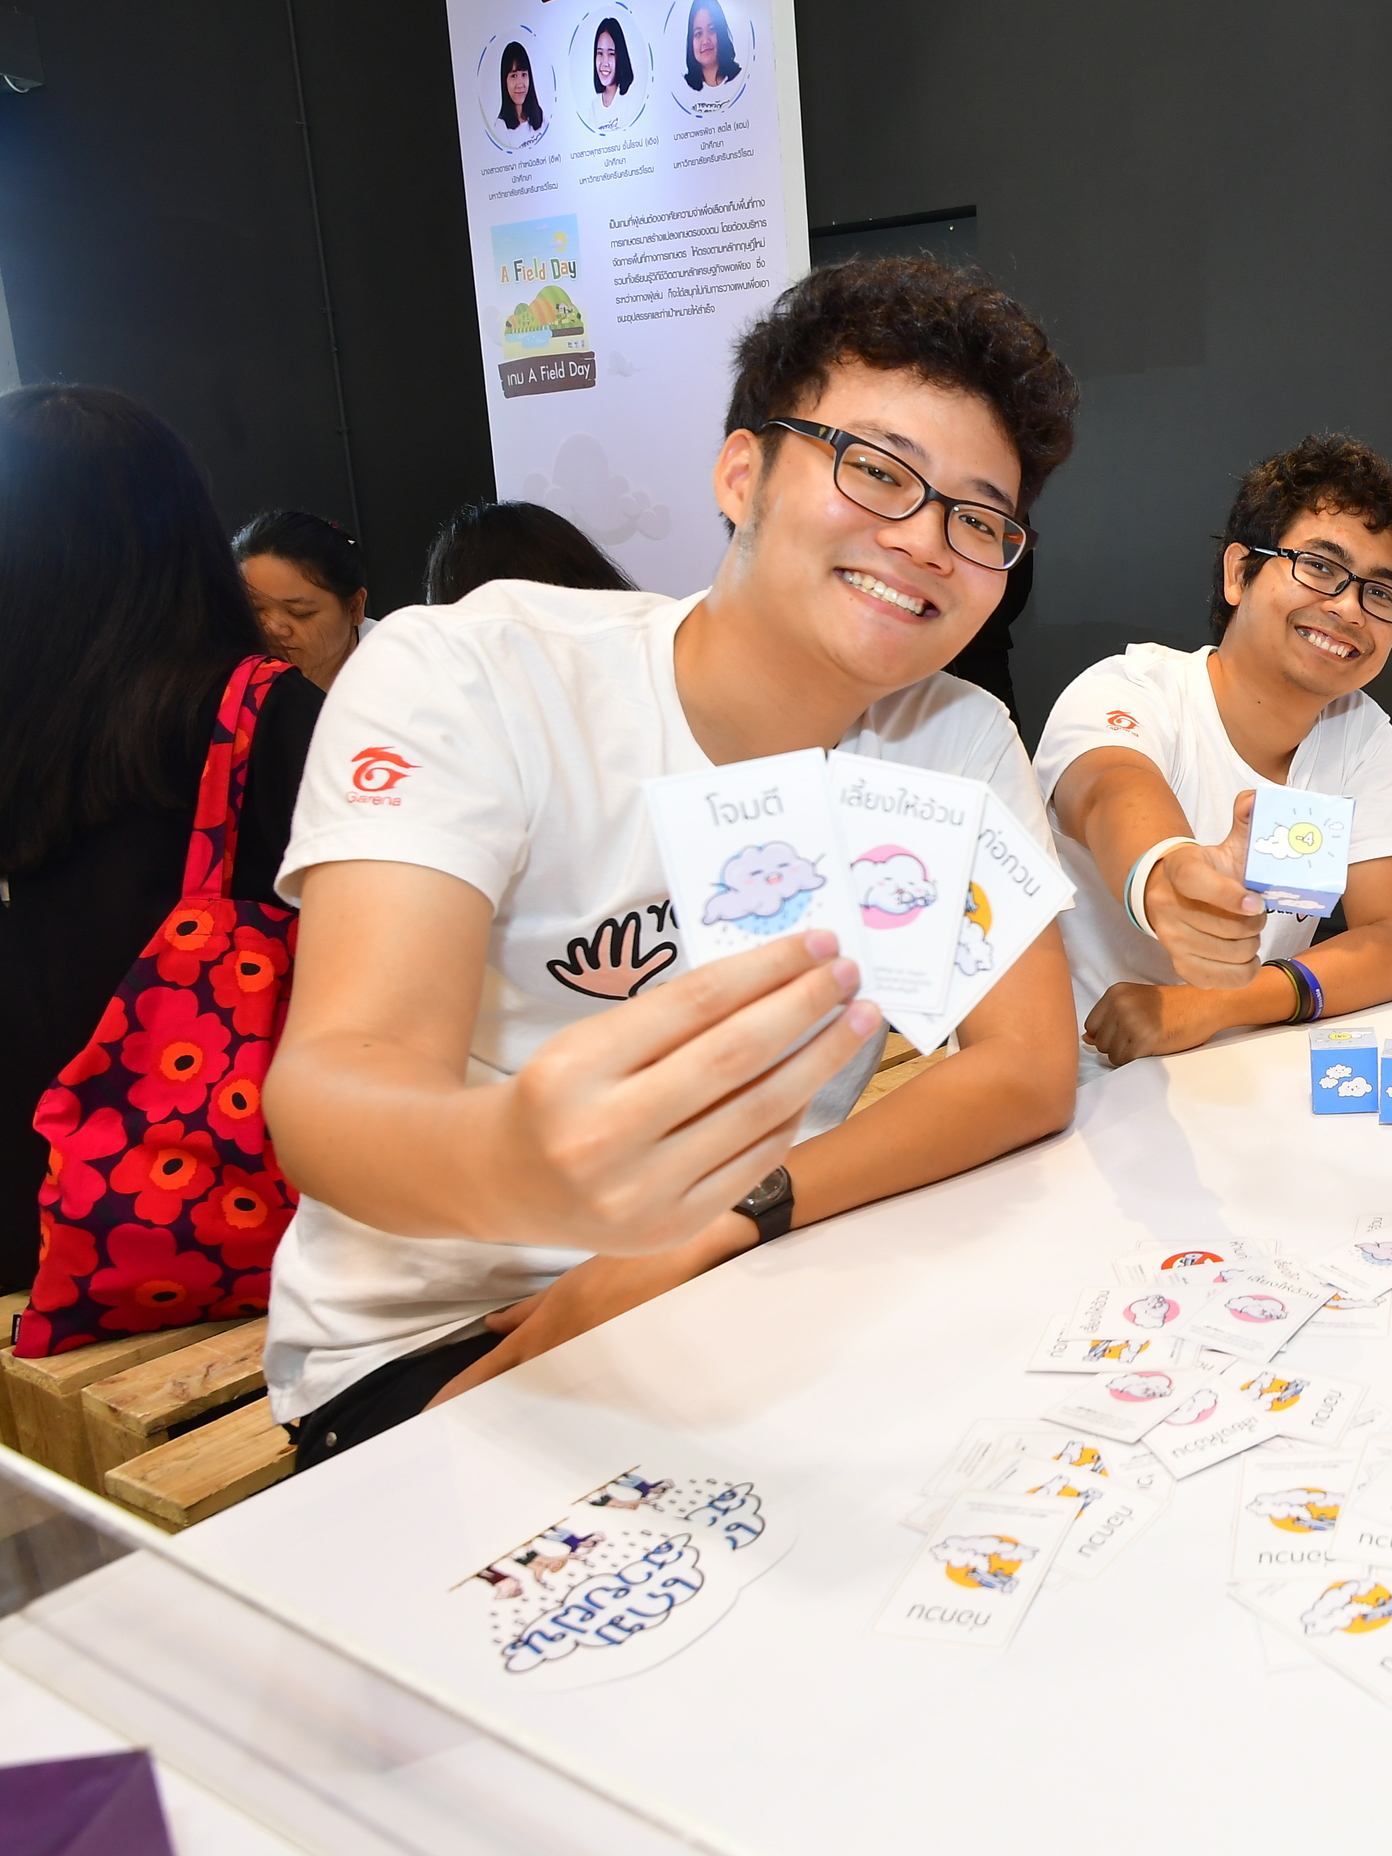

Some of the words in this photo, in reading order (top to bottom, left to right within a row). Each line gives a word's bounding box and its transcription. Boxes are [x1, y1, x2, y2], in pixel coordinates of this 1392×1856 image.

[501, 265, 510, 283] A
[514, 257, 546, 281] Field
[550, 257, 577, 280] Day
[507, 372, 525, 387] เกม
[528, 367, 539, 383] A
[540, 360, 566, 381] Field
[568, 360, 590, 380] Day
[345, 791, 402, 806] Garena
[840, 777, 966, 827] เลี้ยงให้อ้วน
[1295, 831, 1315, 847] -4
[978, 827, 1042, 898] ก่อกวน
[907, 1603, 993, 1632] ก่อกวน
